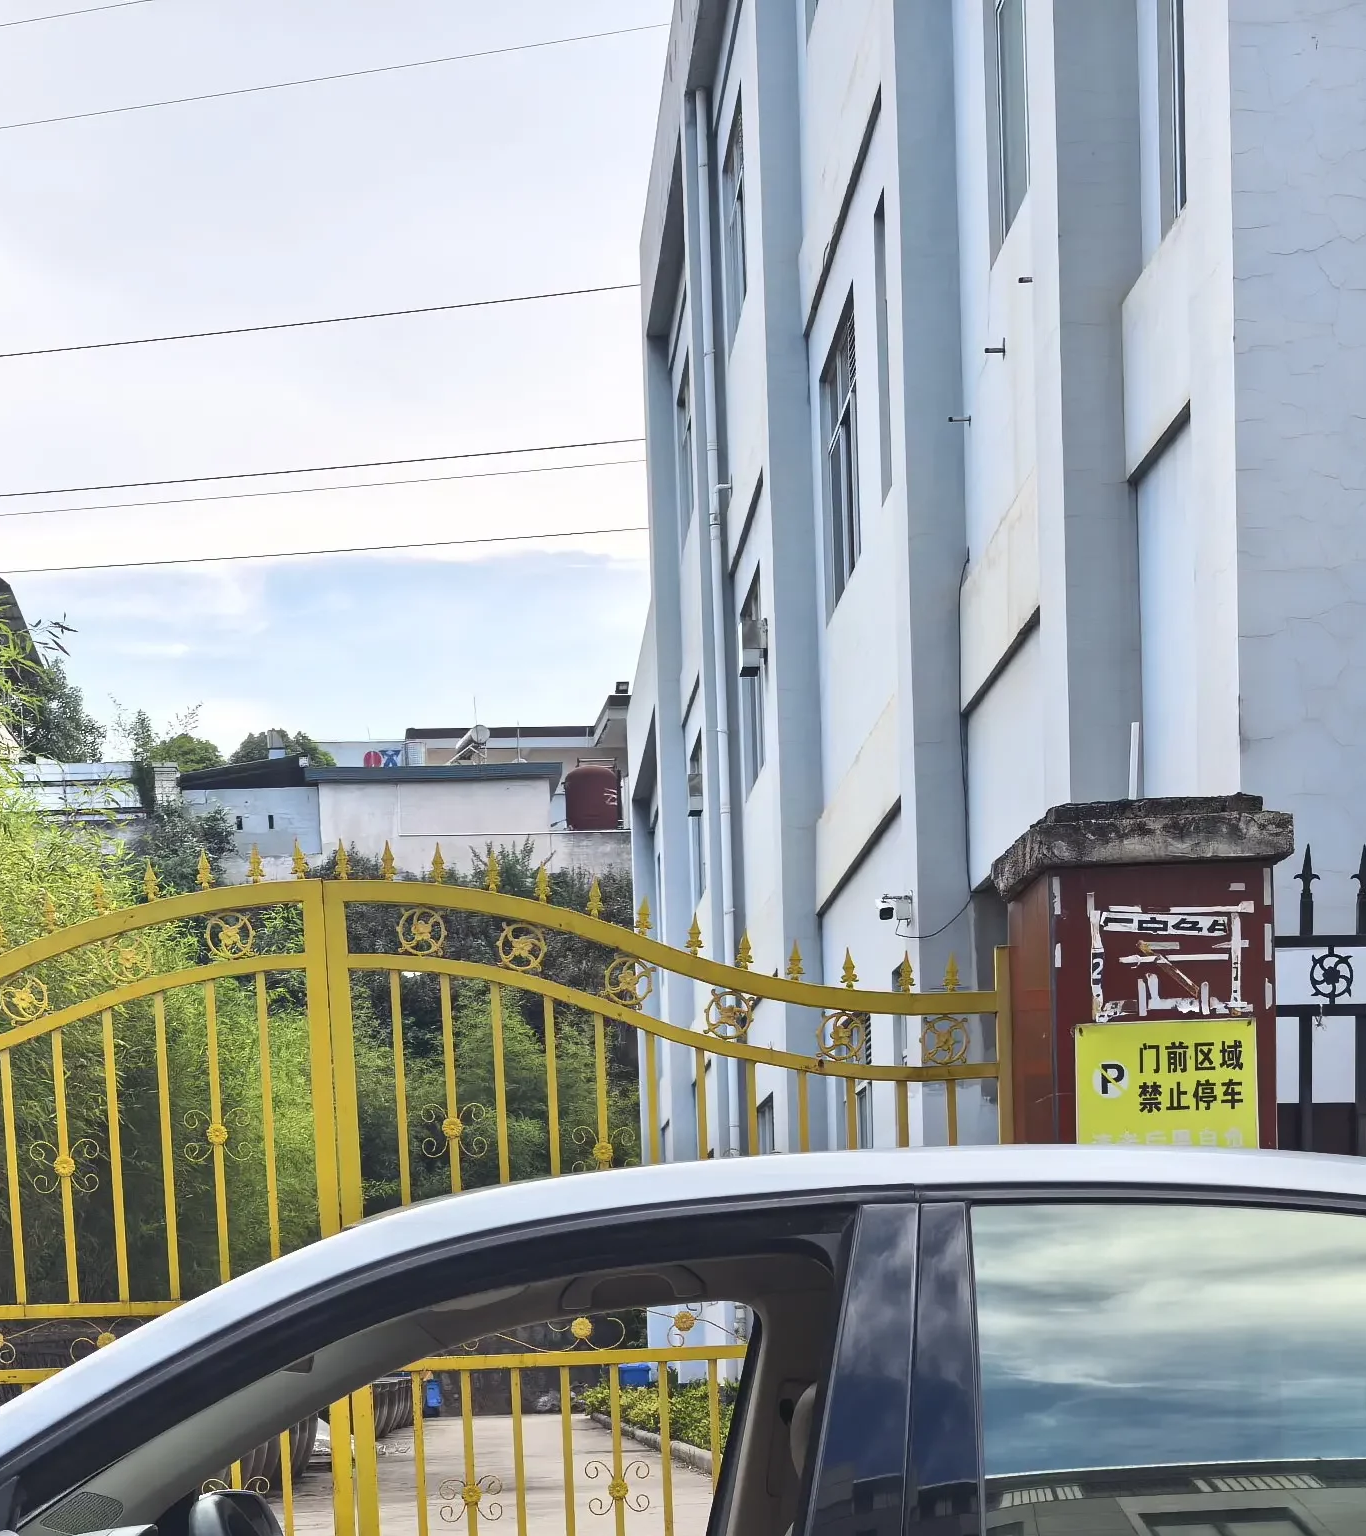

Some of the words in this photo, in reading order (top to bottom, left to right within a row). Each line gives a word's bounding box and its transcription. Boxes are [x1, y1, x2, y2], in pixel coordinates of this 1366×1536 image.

[1139, 1040, 1244, 1074] 门前区域
[1101, 1063, 1125, 1095] P
[1138, 1078, 1244, 1114] 禁止停车
